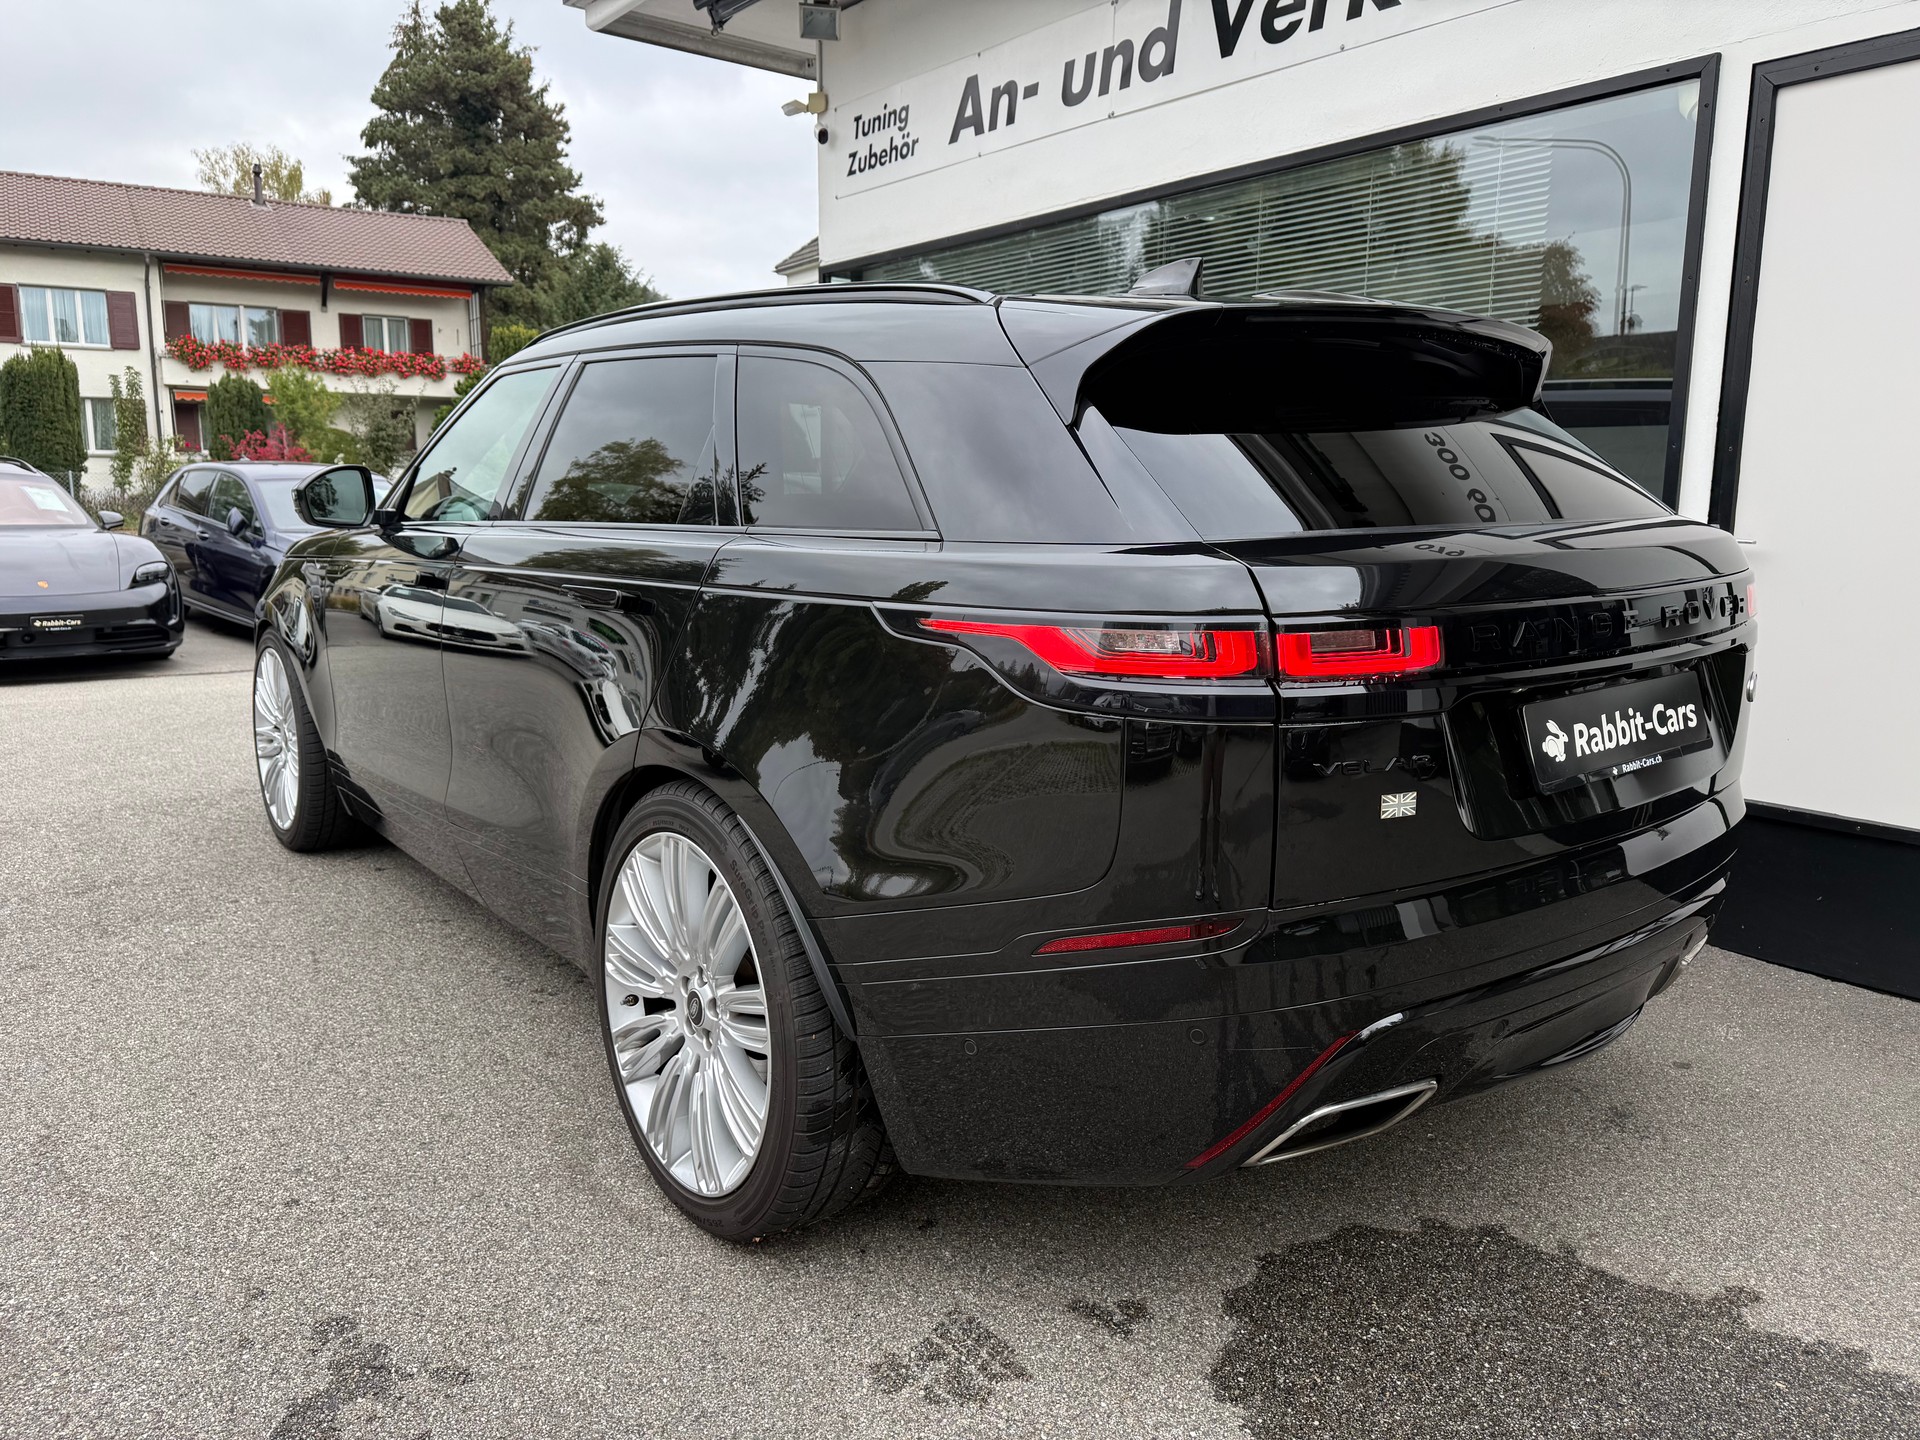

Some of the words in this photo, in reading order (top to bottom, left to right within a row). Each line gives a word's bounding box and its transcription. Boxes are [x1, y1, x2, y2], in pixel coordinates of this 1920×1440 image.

[948, 74, 1039, 145] An-
[1061, 0, 1182, 107] und
[854, 103, 910, 139] Tuning
[846, 132, 920, 177] Zubehör
[1469, 609, 1640, 653] RANGE
[1573, 703, 1698, 757] Rabbit-Cars
[1312, 754, 1434, 776] VELAR
[1621, 754, 1663, 773] Rabbit-Cars.ch
